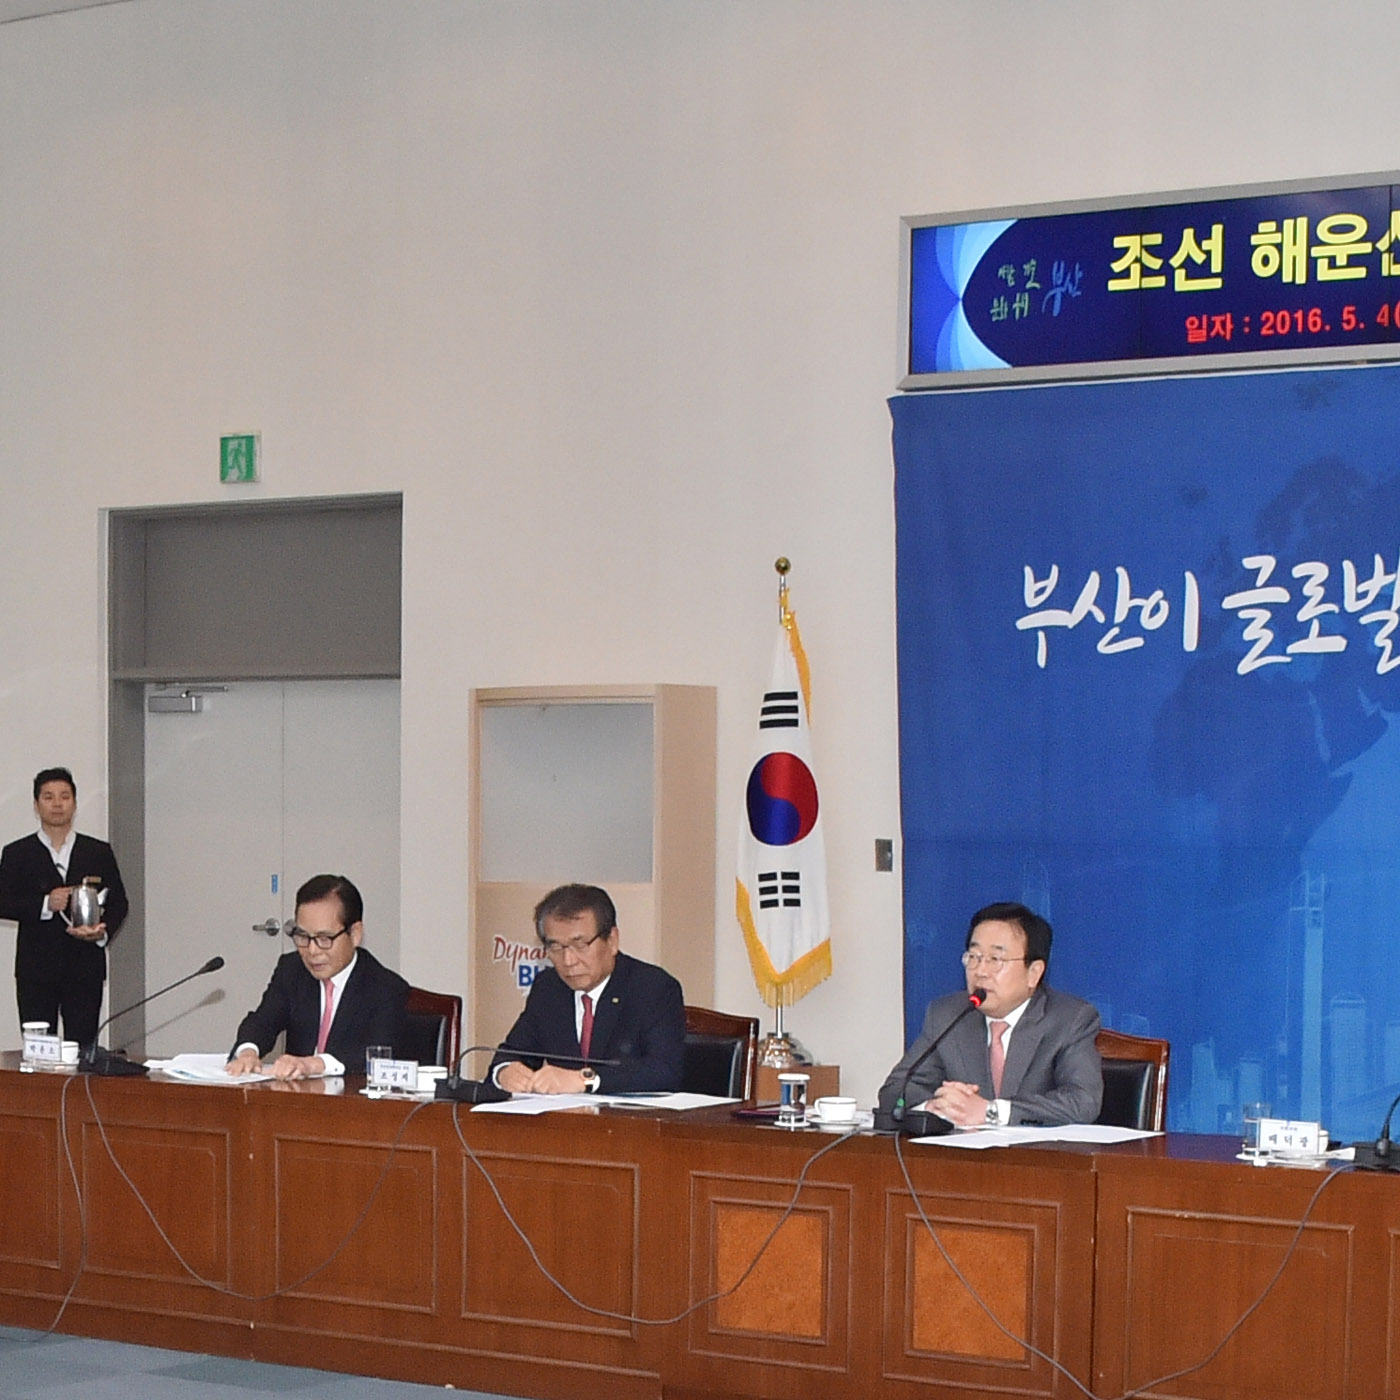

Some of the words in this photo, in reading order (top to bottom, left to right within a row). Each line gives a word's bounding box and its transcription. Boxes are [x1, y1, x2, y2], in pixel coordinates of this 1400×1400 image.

[1109, 223, 1223, 292] 조선
[1185, 312, 1234, 343] 일자
[1260, 307, 1331, 336] 2016.
[1342, 305, 1365, 331] 5.
[1016, 565, 1199, 668] 부산이
